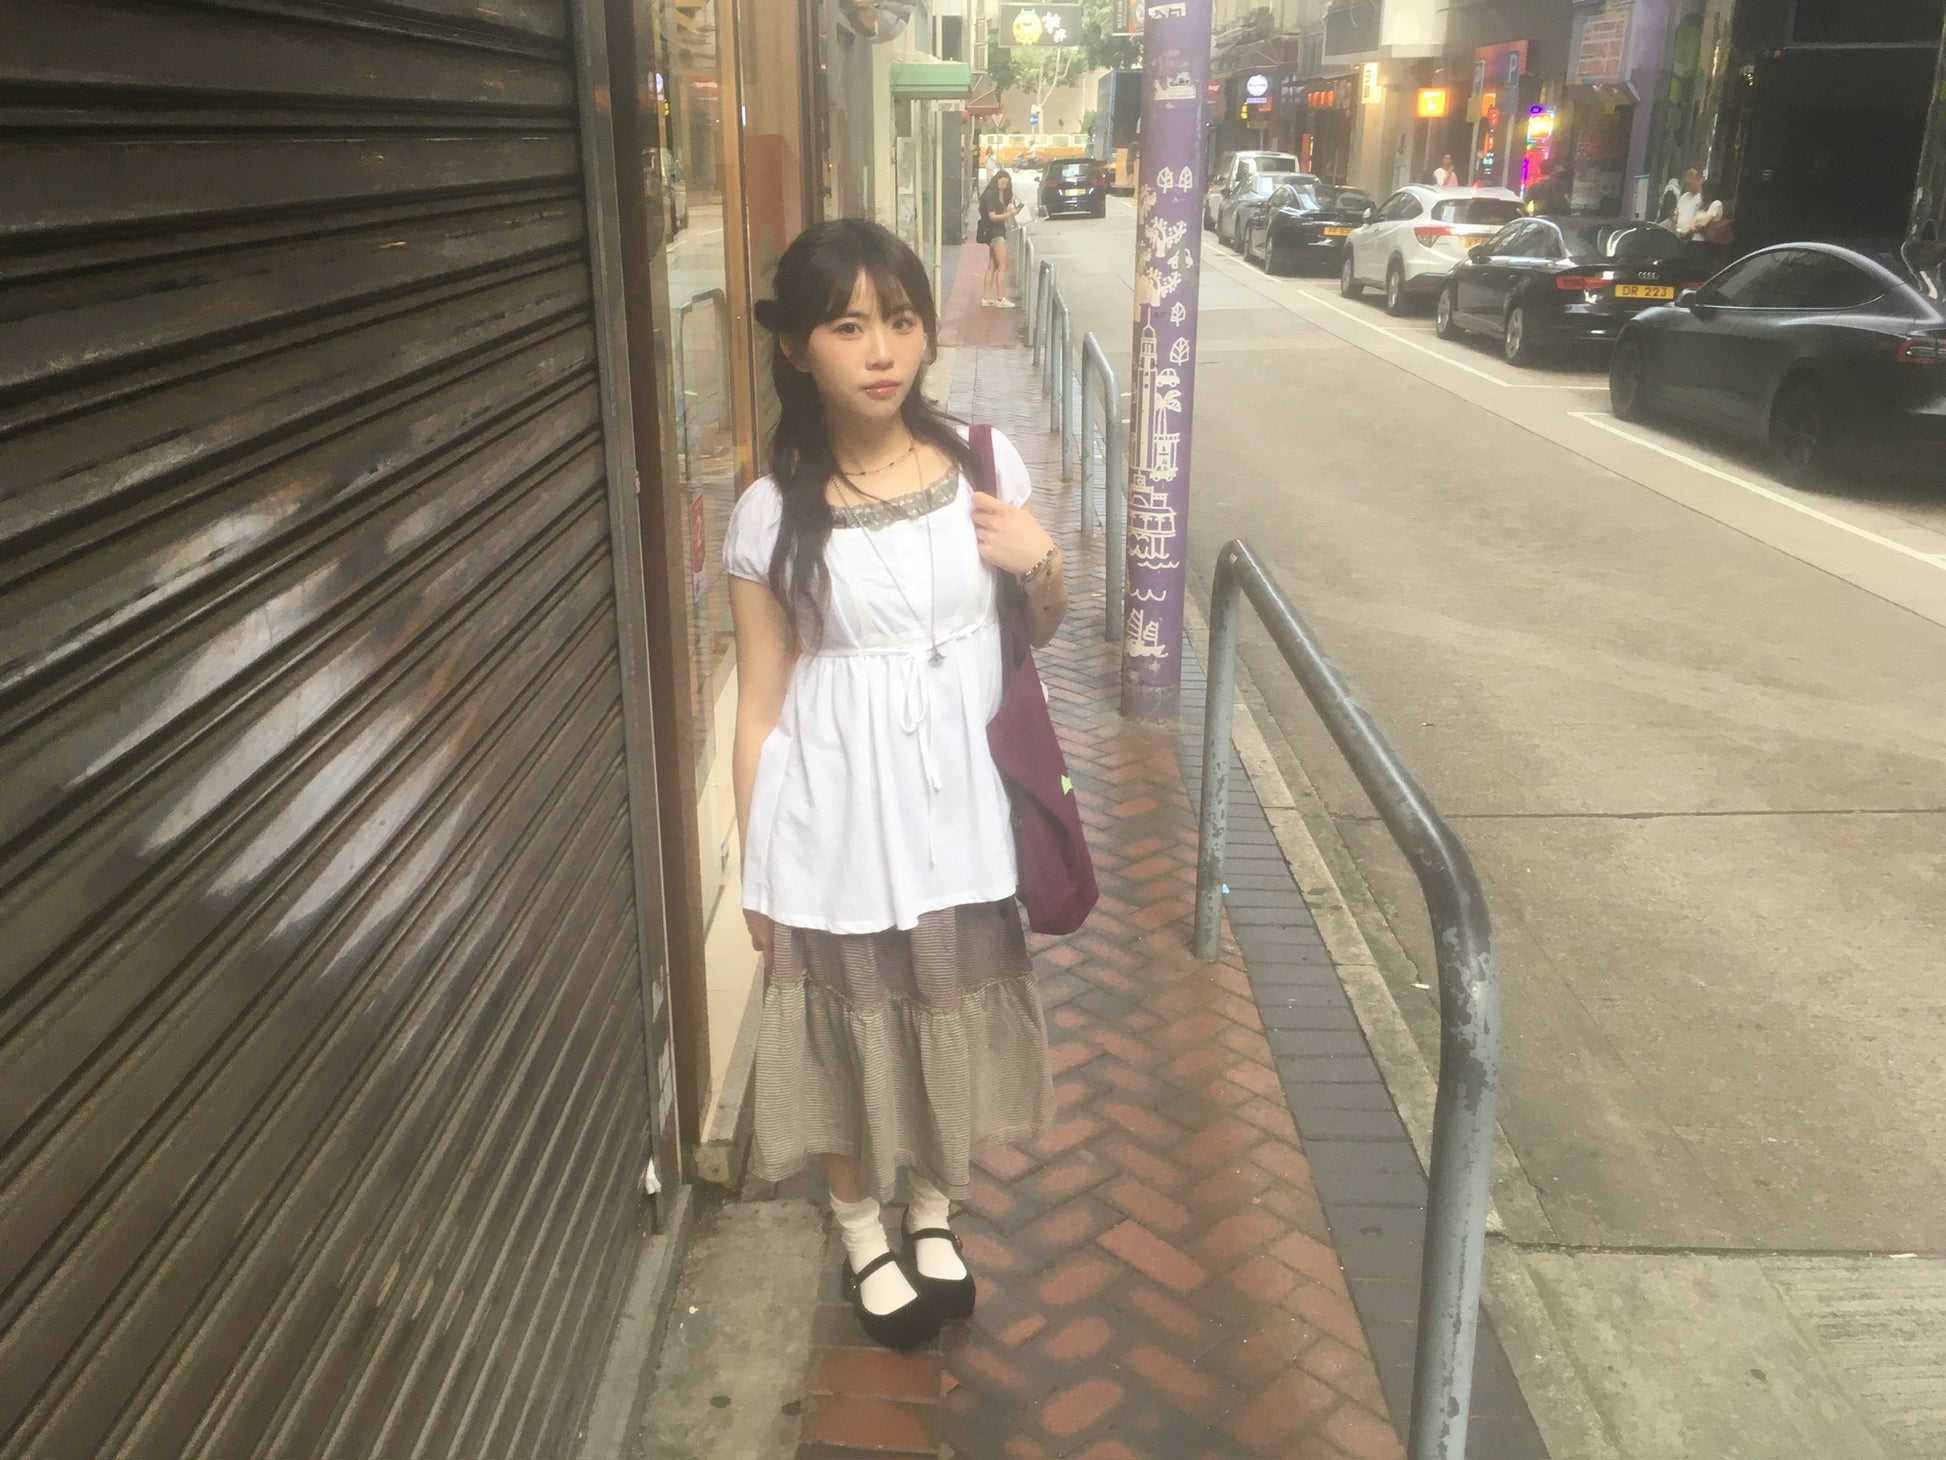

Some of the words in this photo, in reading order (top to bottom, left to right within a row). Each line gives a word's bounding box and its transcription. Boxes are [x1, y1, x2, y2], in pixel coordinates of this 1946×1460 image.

[1509, 54, 1517, 83] P
[1622, 285, 1639, 296] DR
[1644, 286, 1668, 297] 223
